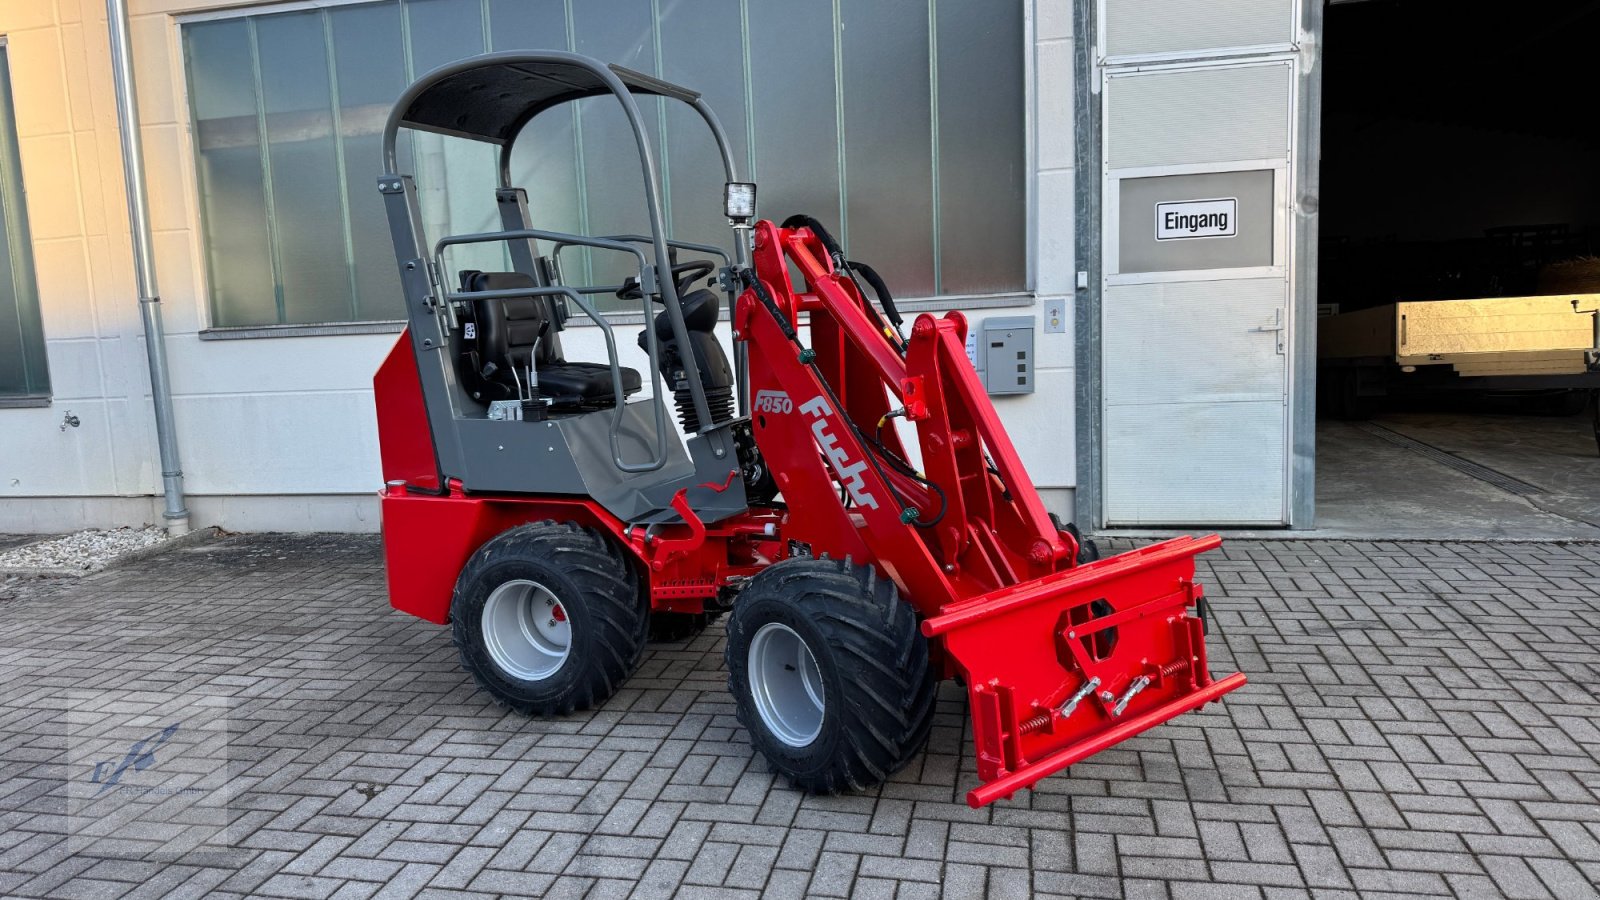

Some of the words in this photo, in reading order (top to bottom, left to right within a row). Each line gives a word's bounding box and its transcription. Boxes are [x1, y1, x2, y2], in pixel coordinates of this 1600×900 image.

[1165, 212, 1228, 232] Eingang
[754, 389, 793, 415] F850
[798, 395, 879, 511] Fuchs
